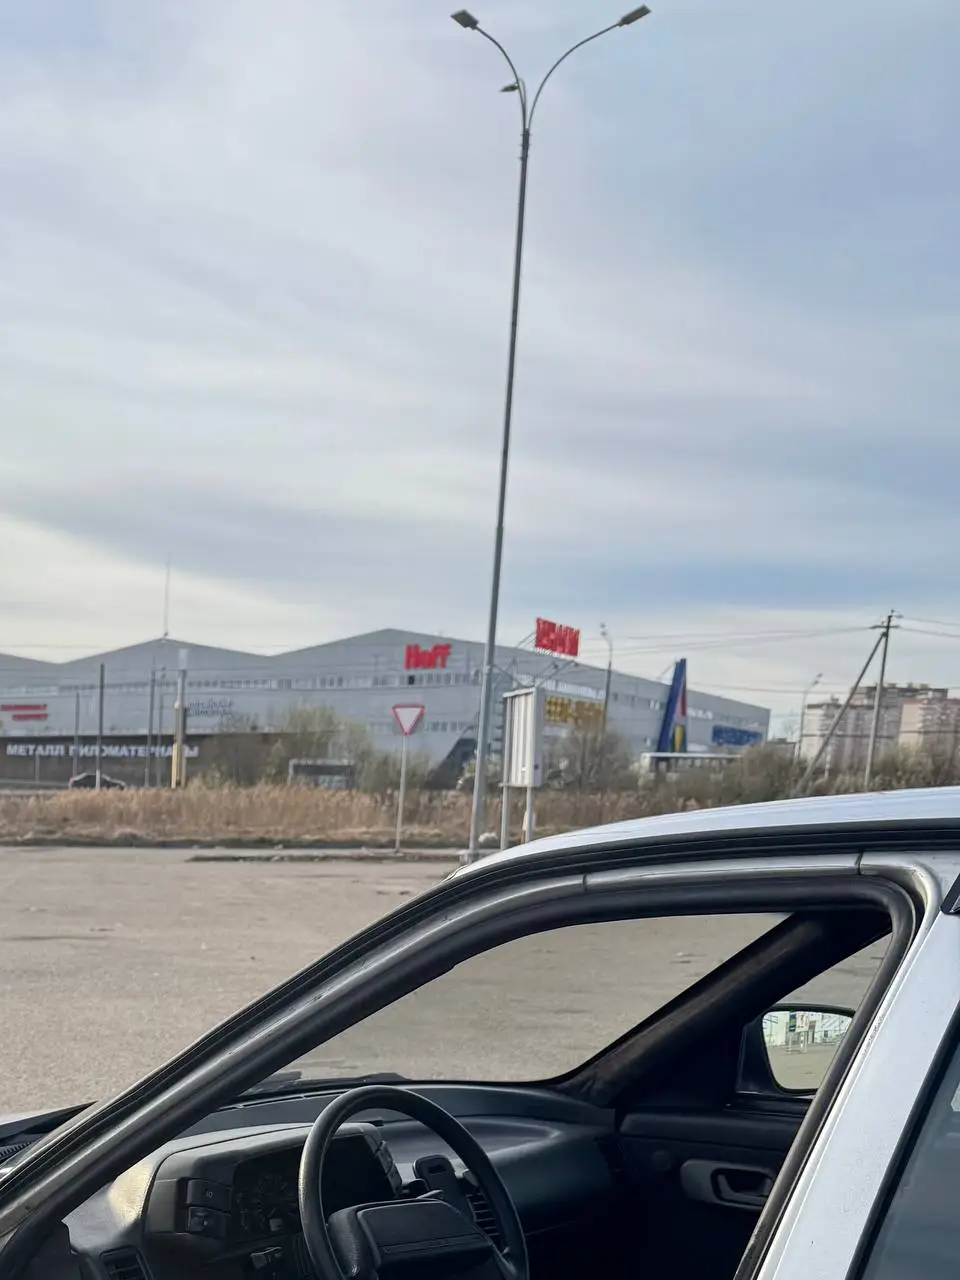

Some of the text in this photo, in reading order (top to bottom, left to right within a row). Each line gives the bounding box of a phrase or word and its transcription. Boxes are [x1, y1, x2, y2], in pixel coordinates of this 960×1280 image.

[405, 643, 452, 669] Hoff
[6, 743, 199, 757] МЕТАЛЛ ПИЛОМАТЕРИАЫ
